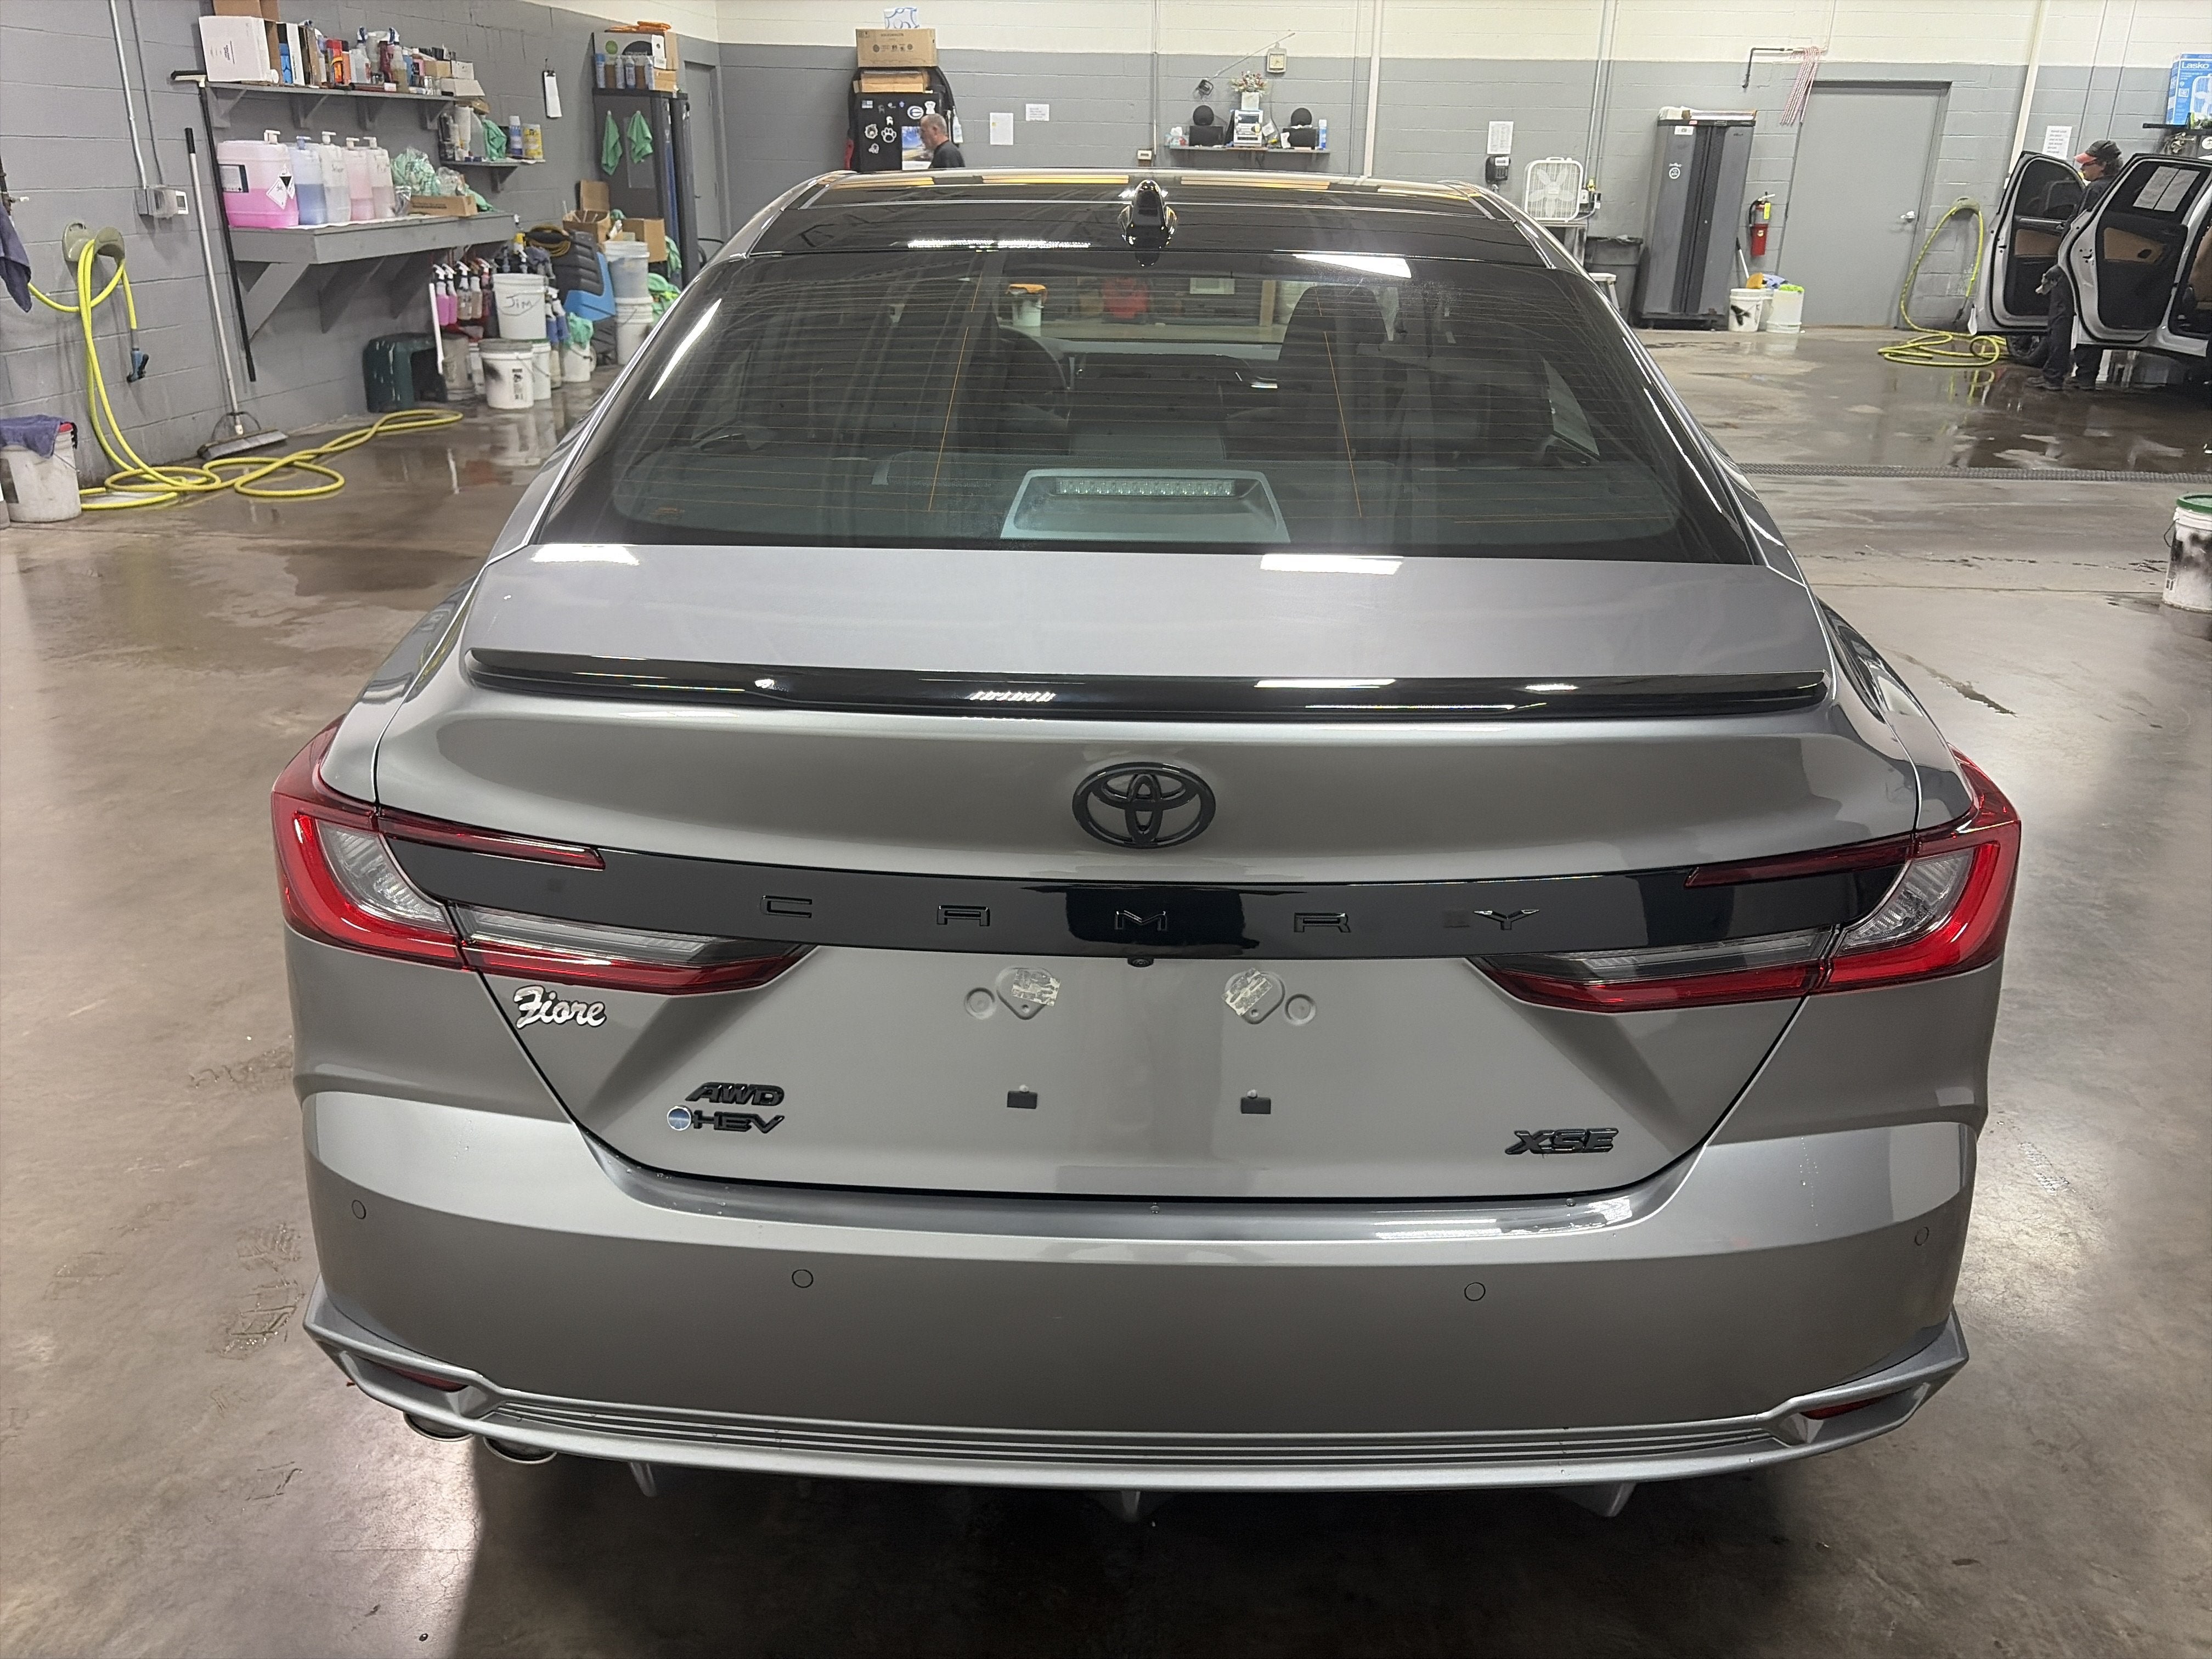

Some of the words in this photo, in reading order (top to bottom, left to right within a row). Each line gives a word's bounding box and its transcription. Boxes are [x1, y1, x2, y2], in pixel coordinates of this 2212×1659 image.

[761, 895, 1539, 933] CAMRY
[514, 984, 607, 1030] Fiore
[685, 1082, 785, 1107] AWD
[692, 1110, 785, 1134] HEV
[1505, 1127, 1619, 1155] XSE
